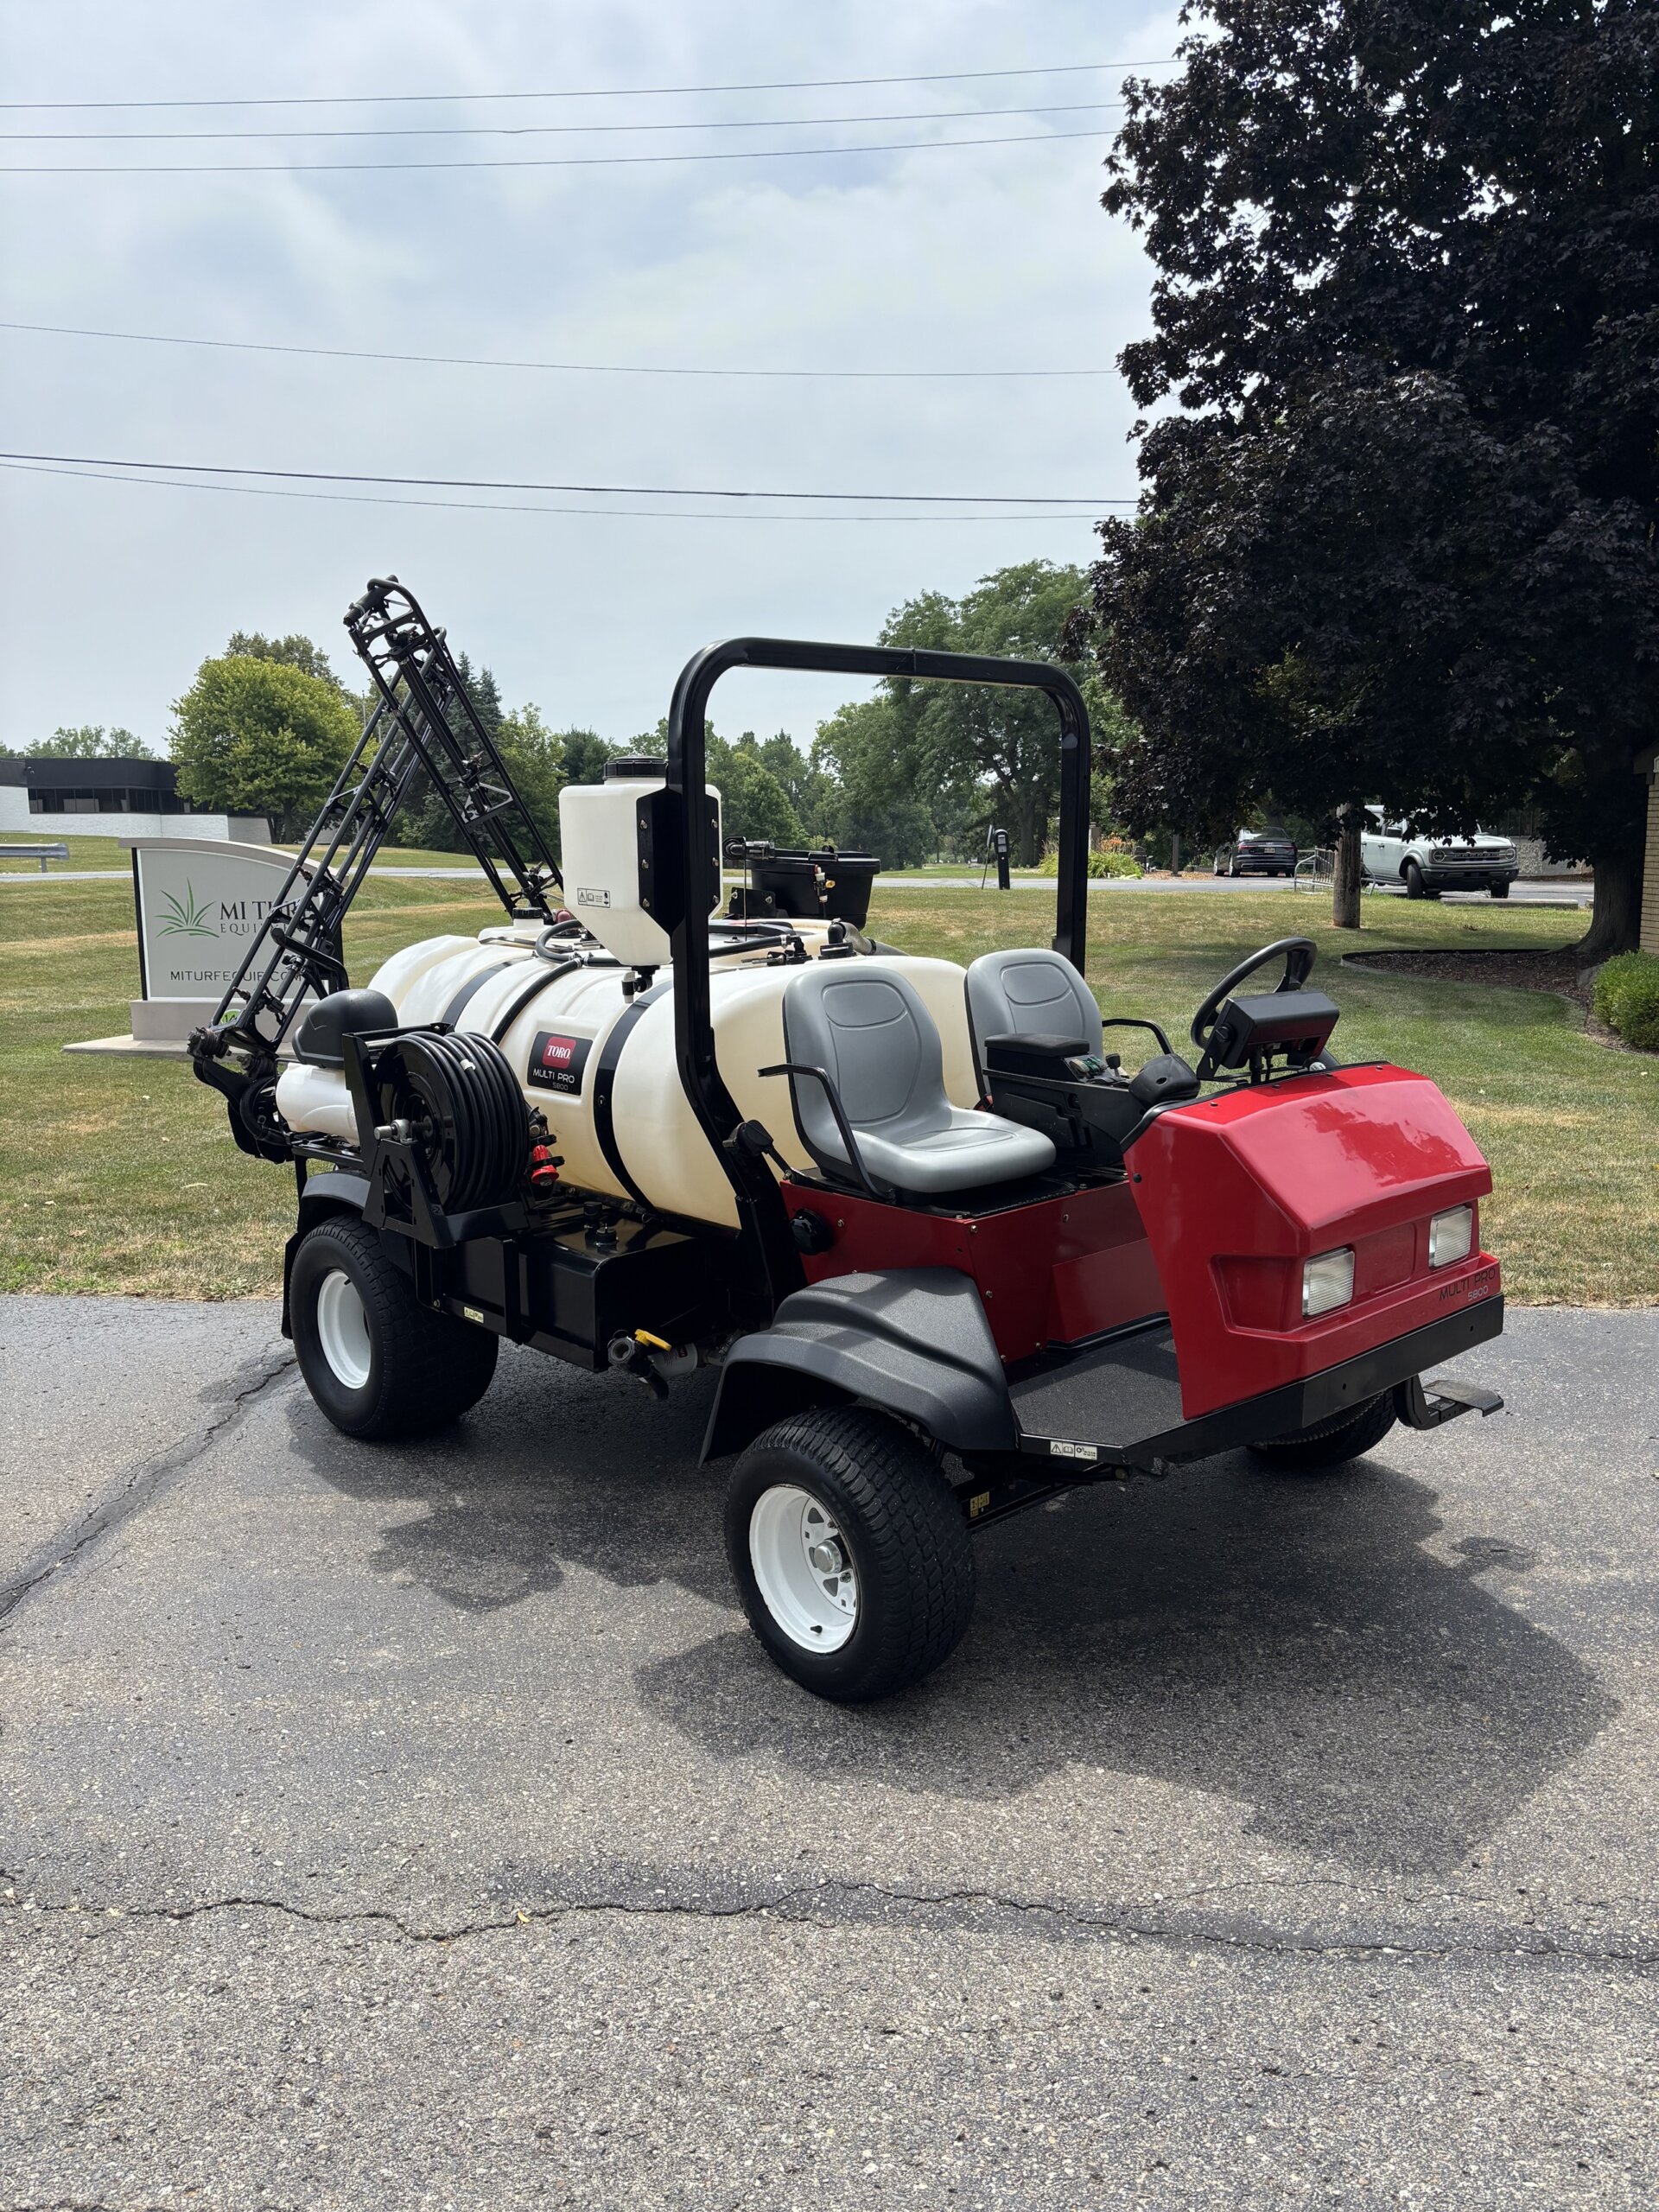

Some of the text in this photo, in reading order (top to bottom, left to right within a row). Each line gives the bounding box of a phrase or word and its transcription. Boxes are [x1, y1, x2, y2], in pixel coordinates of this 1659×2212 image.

[220, 901, 246, 920] MI
[532, 1068, 575, 1084] MULTI PRO
[552, 1082, 569, 1090] 5800
[1439, 1268, 1496, 1301] MULTI PRO
[1467, 1285, 1489, 1301] 5800
